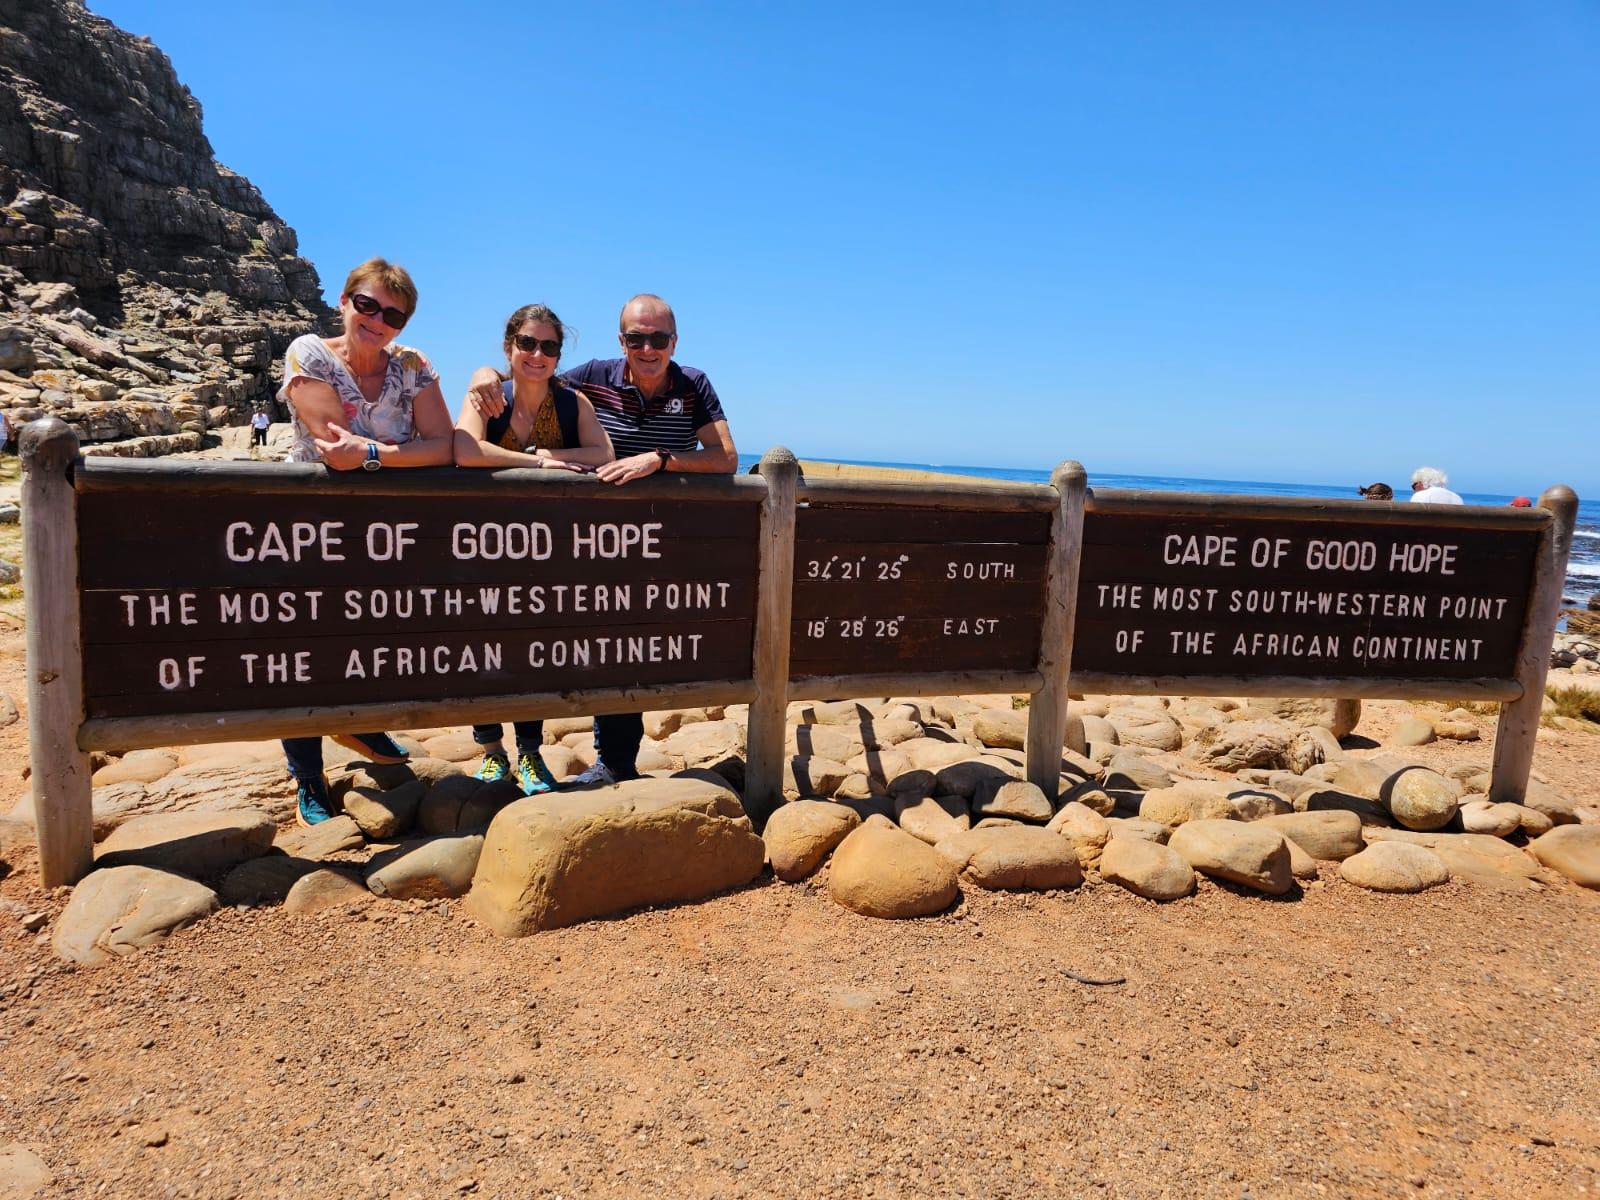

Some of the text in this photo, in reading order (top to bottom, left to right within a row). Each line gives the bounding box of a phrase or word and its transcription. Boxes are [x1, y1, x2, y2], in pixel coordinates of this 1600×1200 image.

[225, 521, 663, 563] CAPE OF GOOD HOPE
[1163, 534, 1458, 575] CAPE OF GOOD HOPE
[946, 561, 1015, 580] SOUTH
[119, 582, 731, 627] THE MOST SOUTH-WESTERN POINT
[1097, 584, 1507, 620] THE MOST SOUTH-WESTERN POINT
[943, 618, 999, 636] EAST
[1115, 630, 1483, 661] OF THE AFRICAN CONTINENT
[158, 634, 703, 690] OF THE AFRICAN CONTINENT
